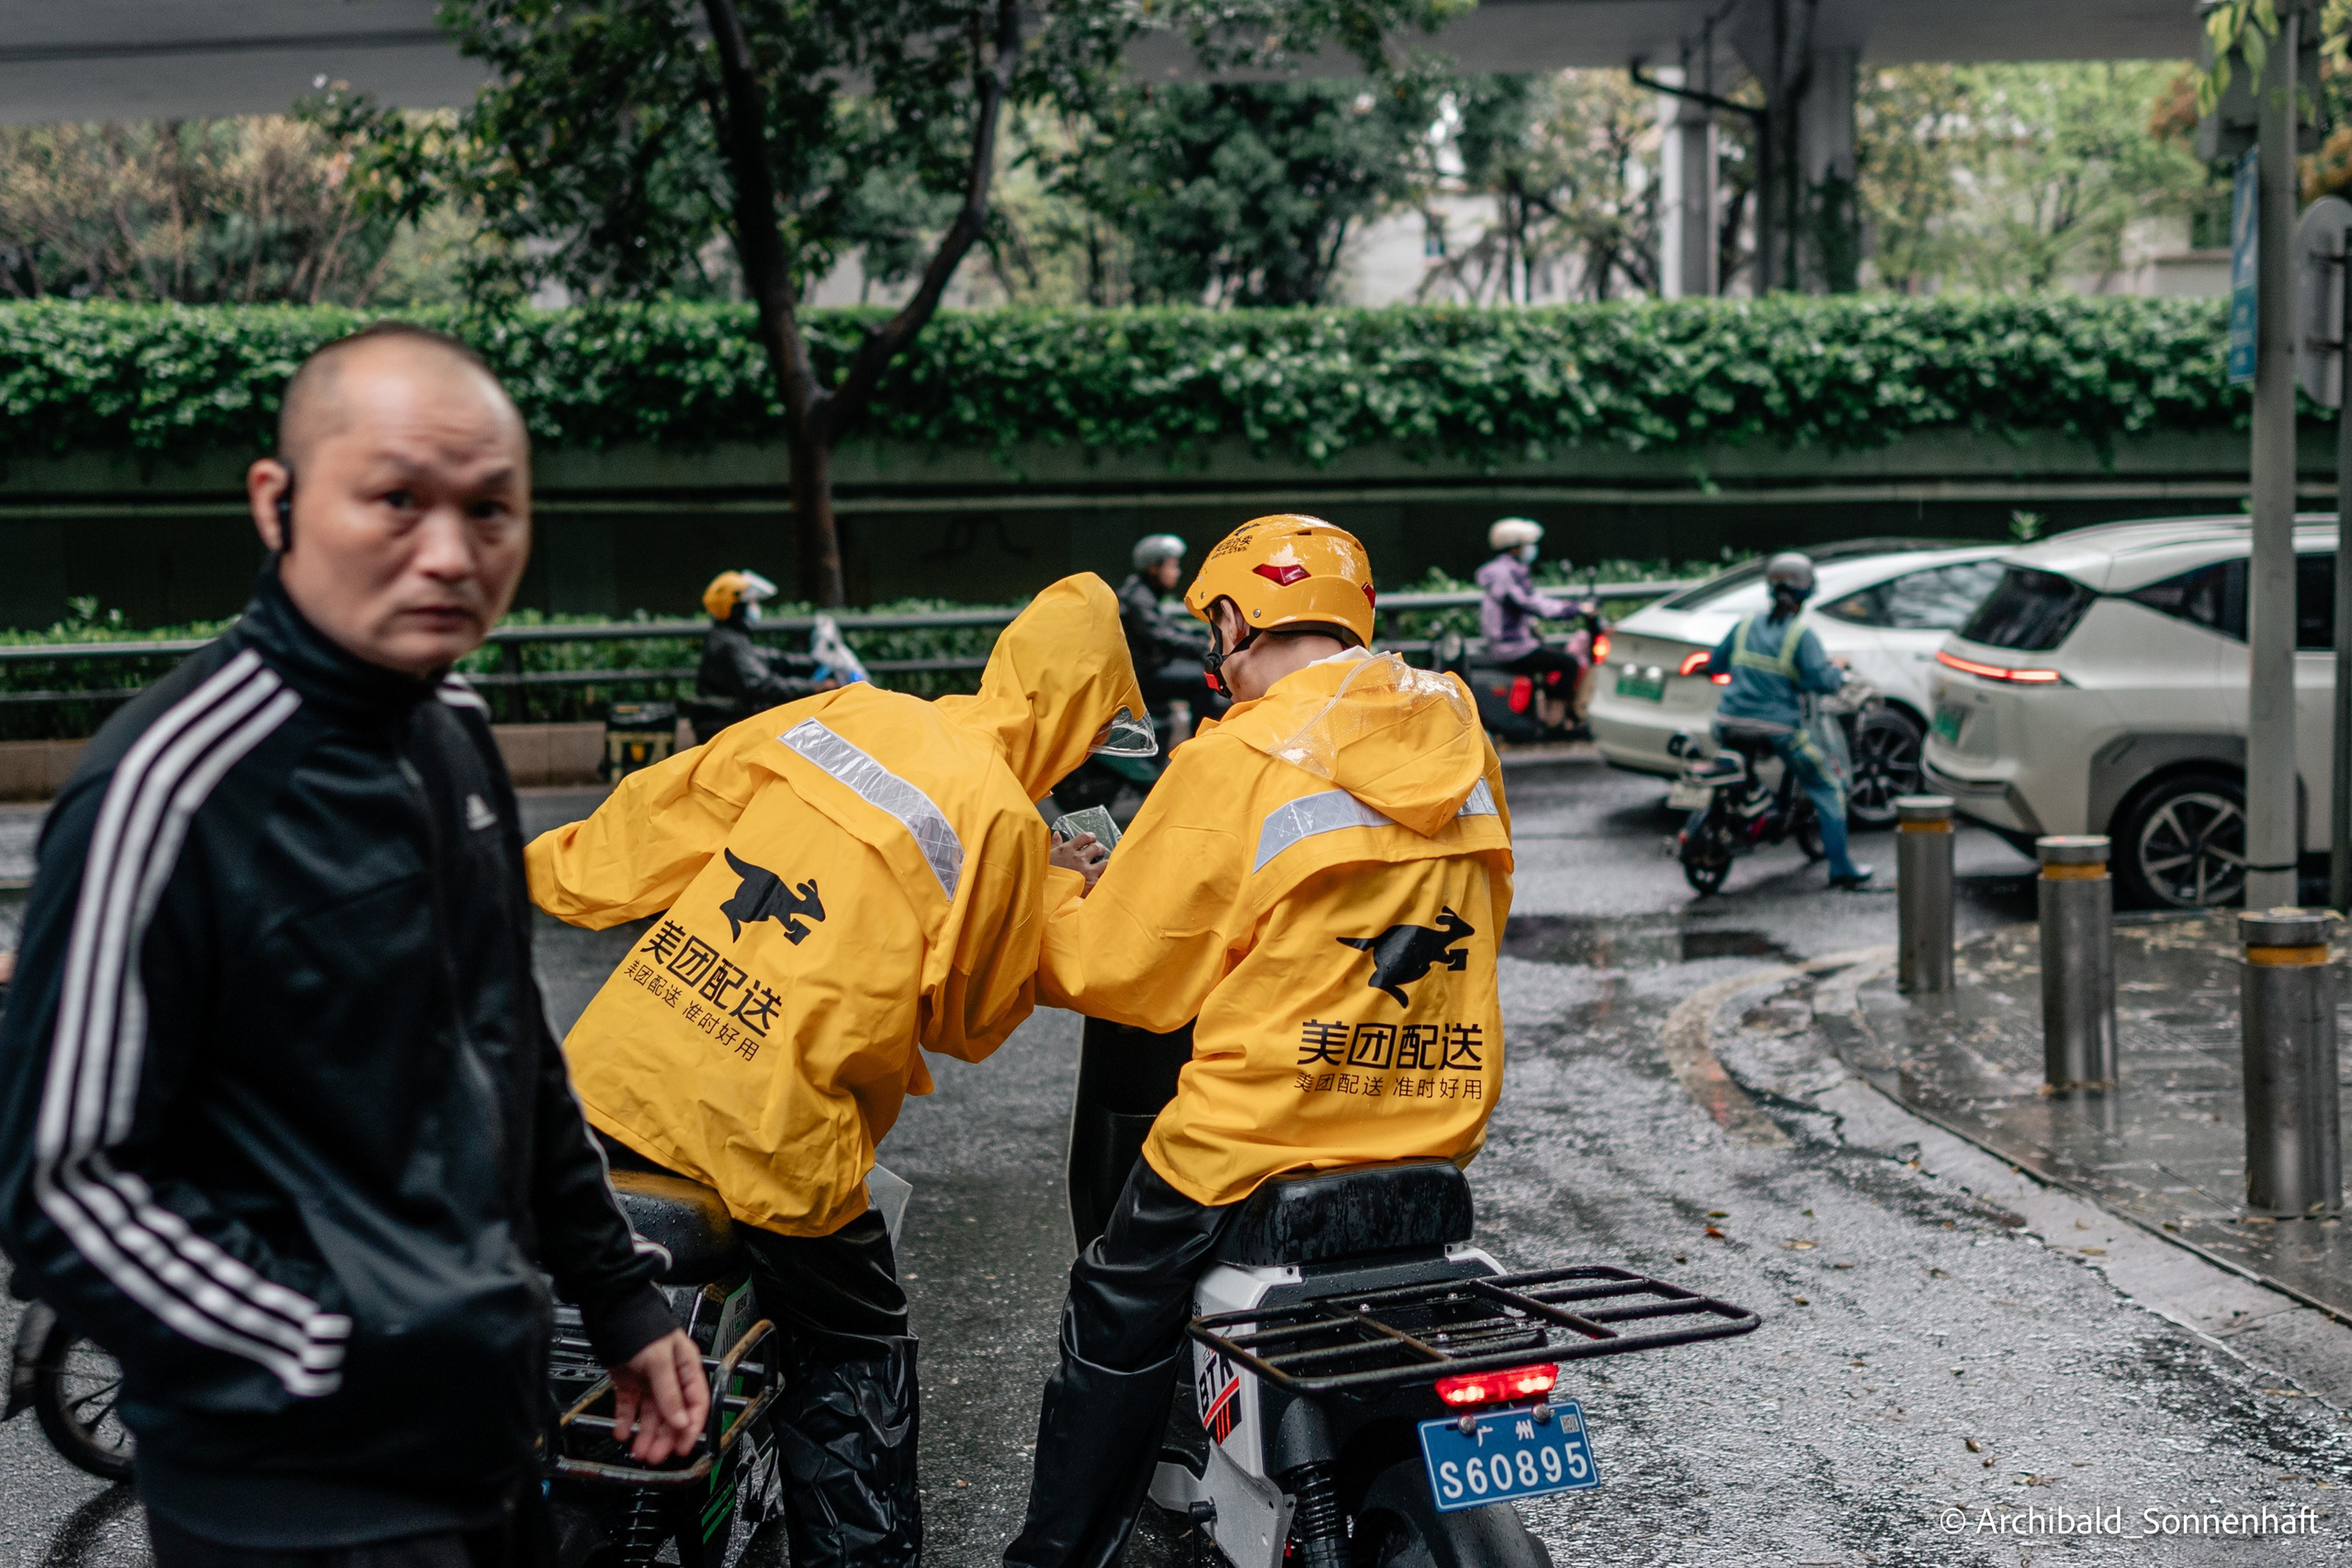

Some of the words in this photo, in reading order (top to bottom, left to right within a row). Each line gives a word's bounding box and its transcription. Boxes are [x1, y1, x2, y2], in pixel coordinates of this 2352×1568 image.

[640, 919, 782, 1038] 美团配送
[624, 959, 684, 1009] 美团配送
[683, 1000, 760, 1062] 准时好用
[1296, 1019, 1483, 1071] 美团配送
[1294, 1071, 1384, 1097] 美团配送
[1393, 1077, 1482, 1100] 准时好用
[1476, 1419, 1535, 1448] 广州
[1440, 1441, 1588, 1499] S60895
